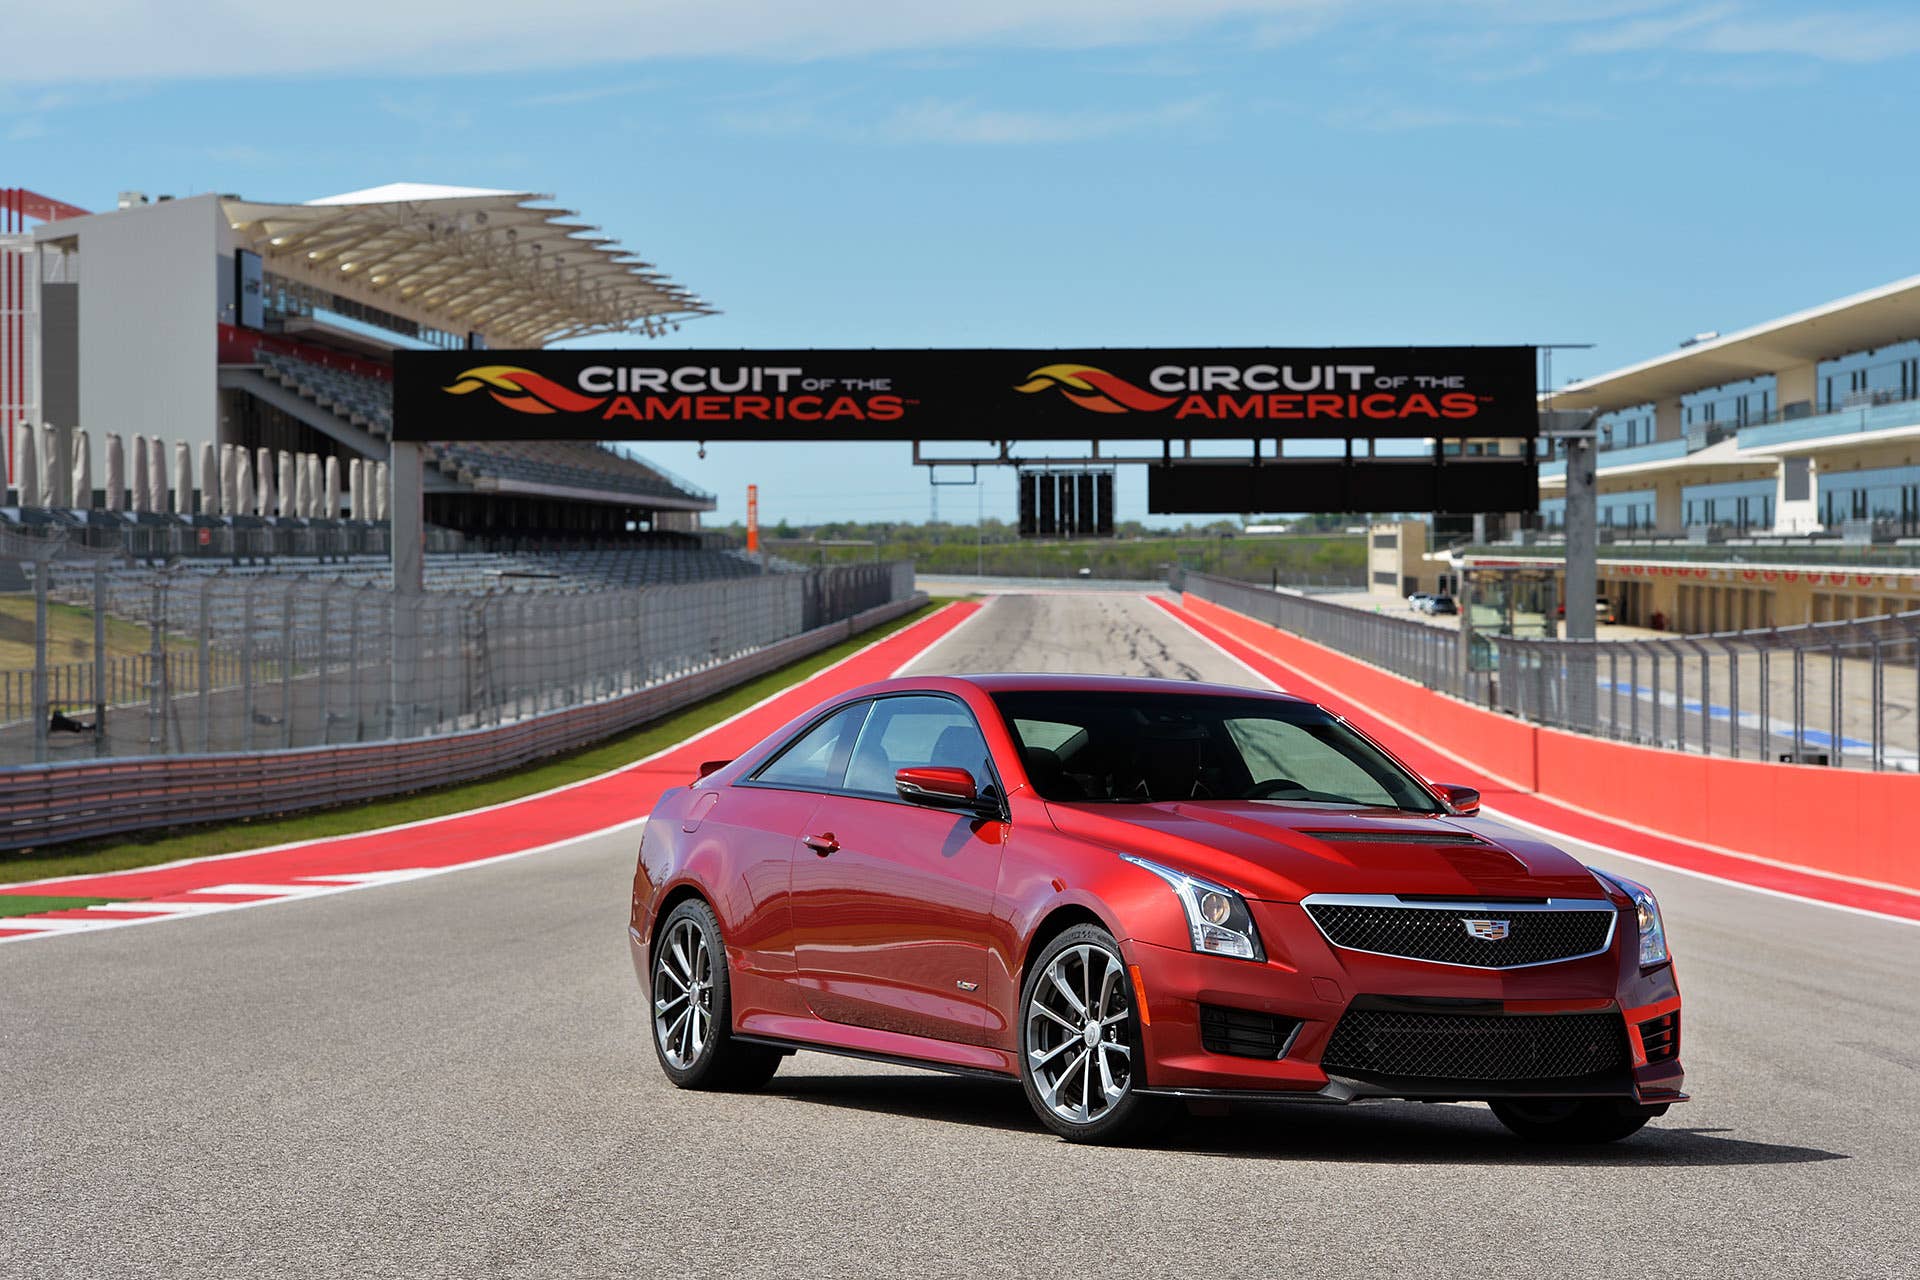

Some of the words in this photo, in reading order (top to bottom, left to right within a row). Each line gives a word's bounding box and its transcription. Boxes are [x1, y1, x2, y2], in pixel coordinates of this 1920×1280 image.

[578, 365, 802, 393] CIRCUIT
[801, 378, 836, 391] OF
[840, 378, 892, 391] THE
[1149, 364, 1375, 392] CIRCUIT
[1374, 375, 1409, 389] OF
[1413, 375, 1465, 389] THE
[601, 395, 905, 421] AMERICAS
[1174, 392, 1479, 419] AMERICAS
